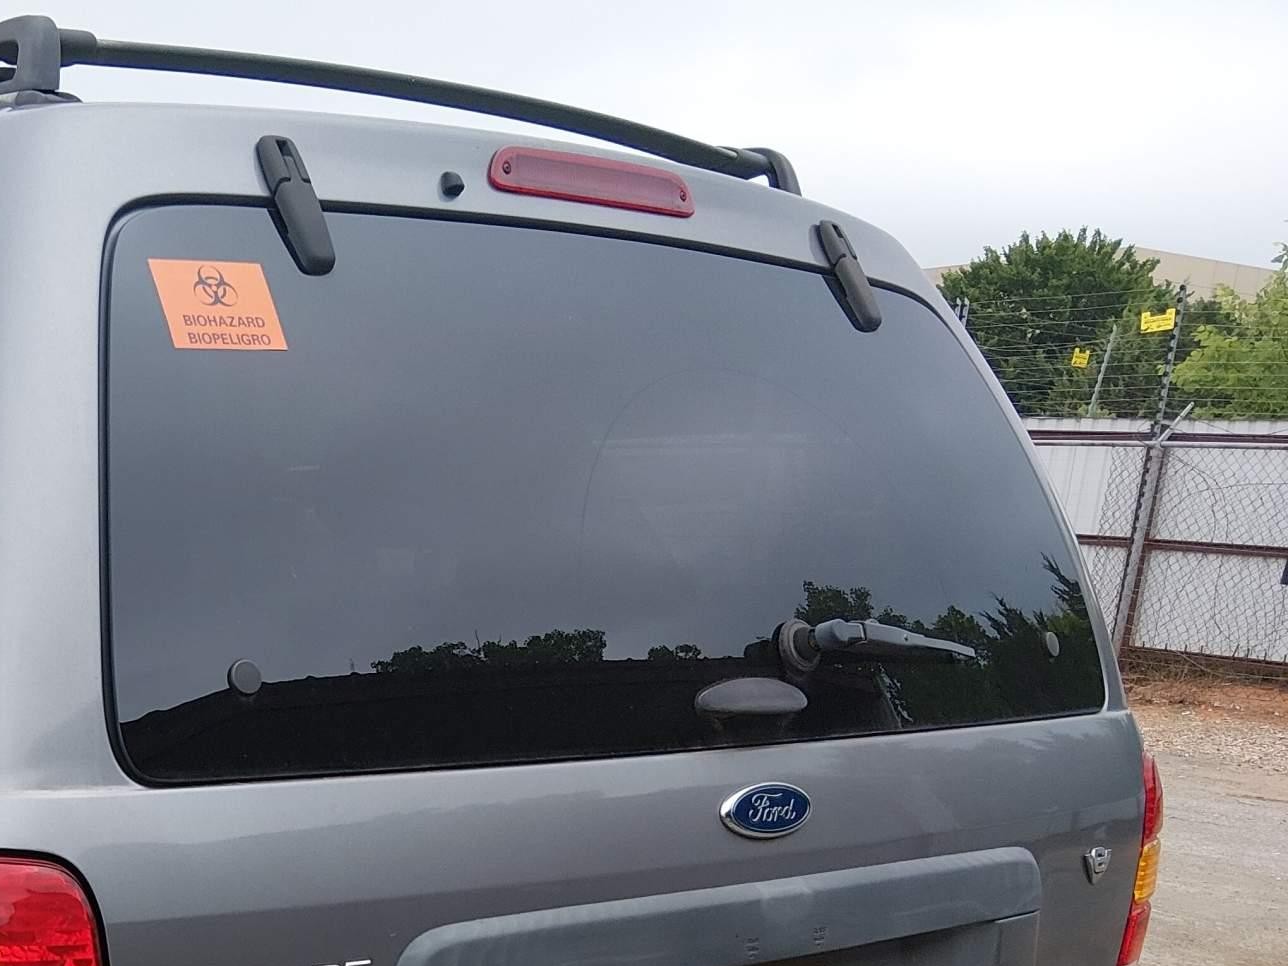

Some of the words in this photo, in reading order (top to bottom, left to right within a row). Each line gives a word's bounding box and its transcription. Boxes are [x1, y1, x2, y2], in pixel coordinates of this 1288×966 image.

[182, 314, 265, 328] BIOHAZARD
[187, 332, 271, 346] BIOPELIGRO
[748, 792, 797, 822] Ford
